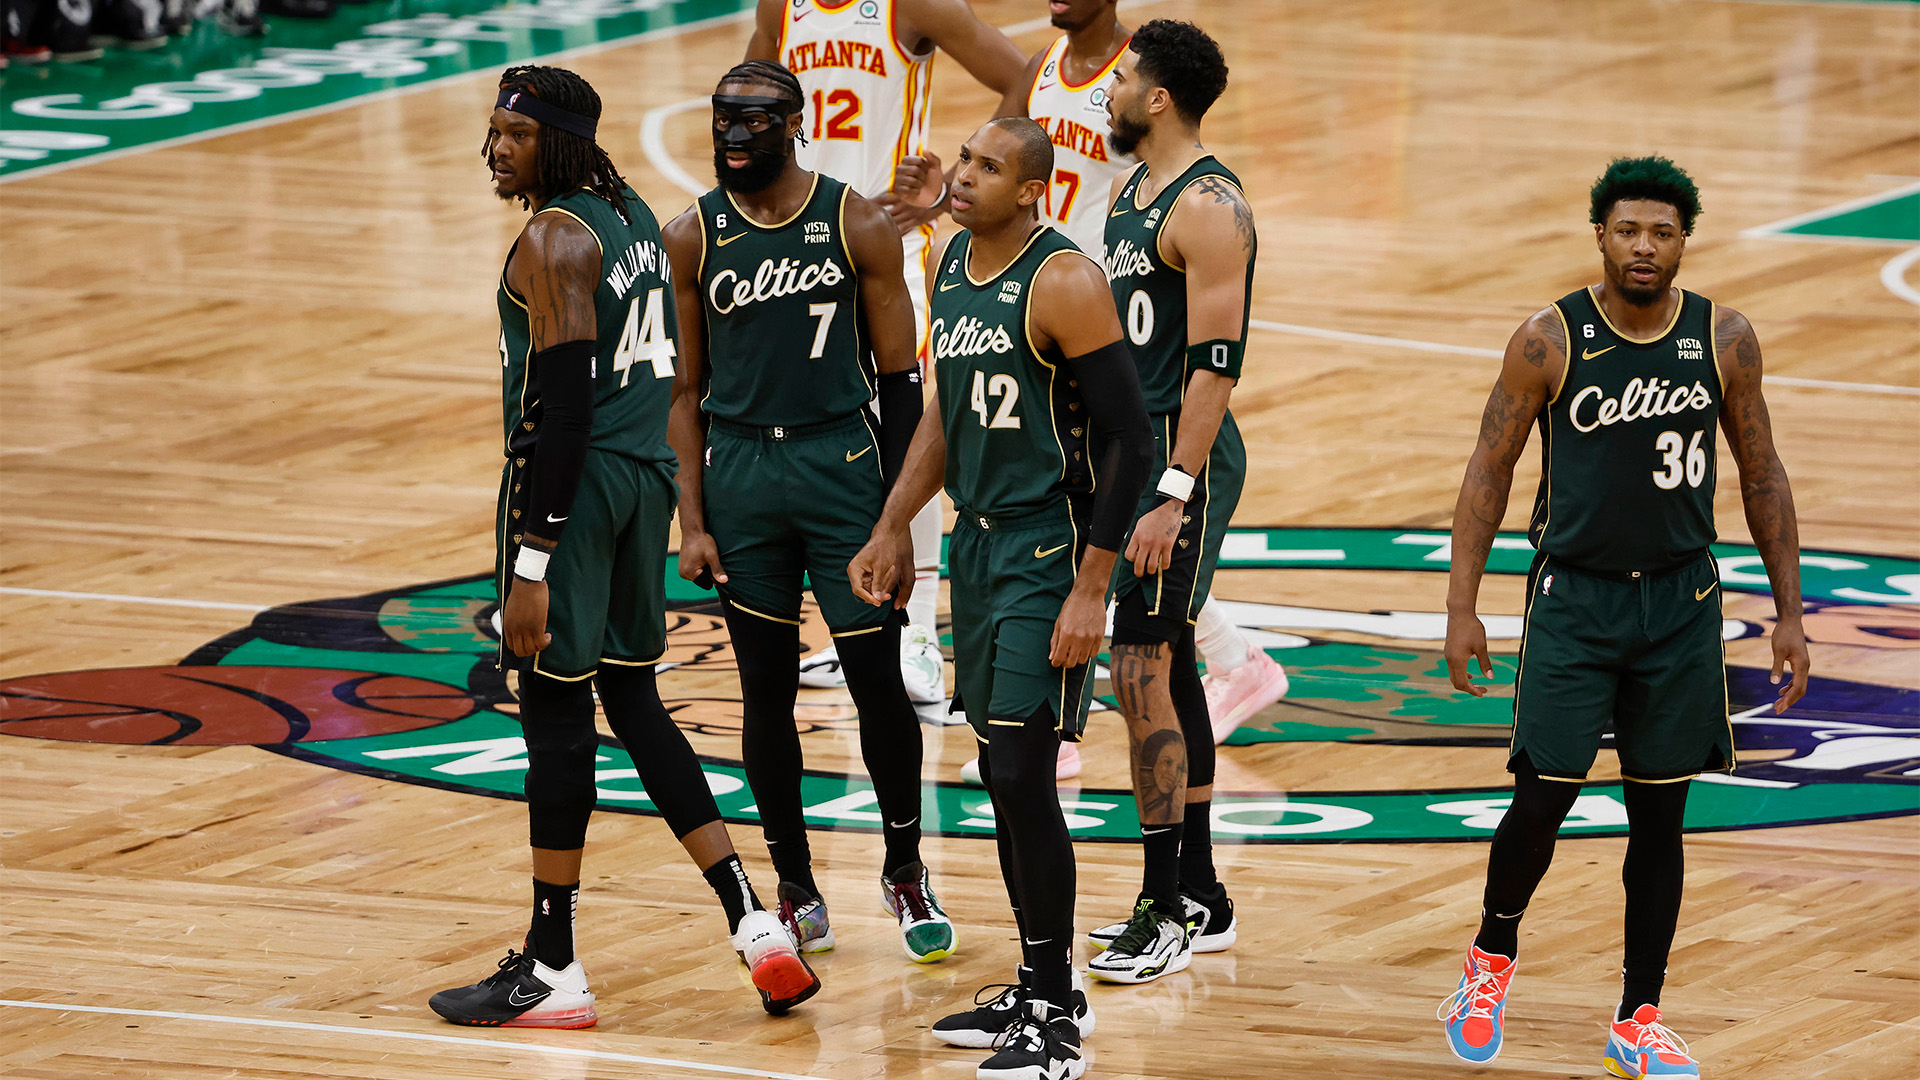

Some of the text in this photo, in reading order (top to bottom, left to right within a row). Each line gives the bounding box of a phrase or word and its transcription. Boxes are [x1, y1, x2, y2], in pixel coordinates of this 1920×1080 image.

[788, 39, 887, 78] ATLANTA
[812, 88, 863, 142] 12
[1122, 184, 1135, 199] 6
[716, 213, 727, 229] 6
[803, 221, 830, 234] VISTA
[804, 233, 831, 244] PRINT
[948, 258, 959, 274] 6
[709, 257, 845, 315] Celtics
[1002, 280, 1022, 295] VISTA
[997, 292, 1019, 305] PRINT
[1127, 289, 1155, 346] 0
[613, 287, 677, 389] 44
[808, 301, 838, 359] 7
[930, 315, 1014, 364] Celtics
[1582, 323, 1595, 339] 6
[1676, 337, 1702, 350] VISTA
[1212, 343, 1228, 368] 0
[1677, 349, 1703, 360] PRINT
[971, 369, 1021, 430] 42
[1569, 377, 1712, 433] Celtics
[773, 426, 784, 439] 6
[1652, 429, 1706, 490] 36
